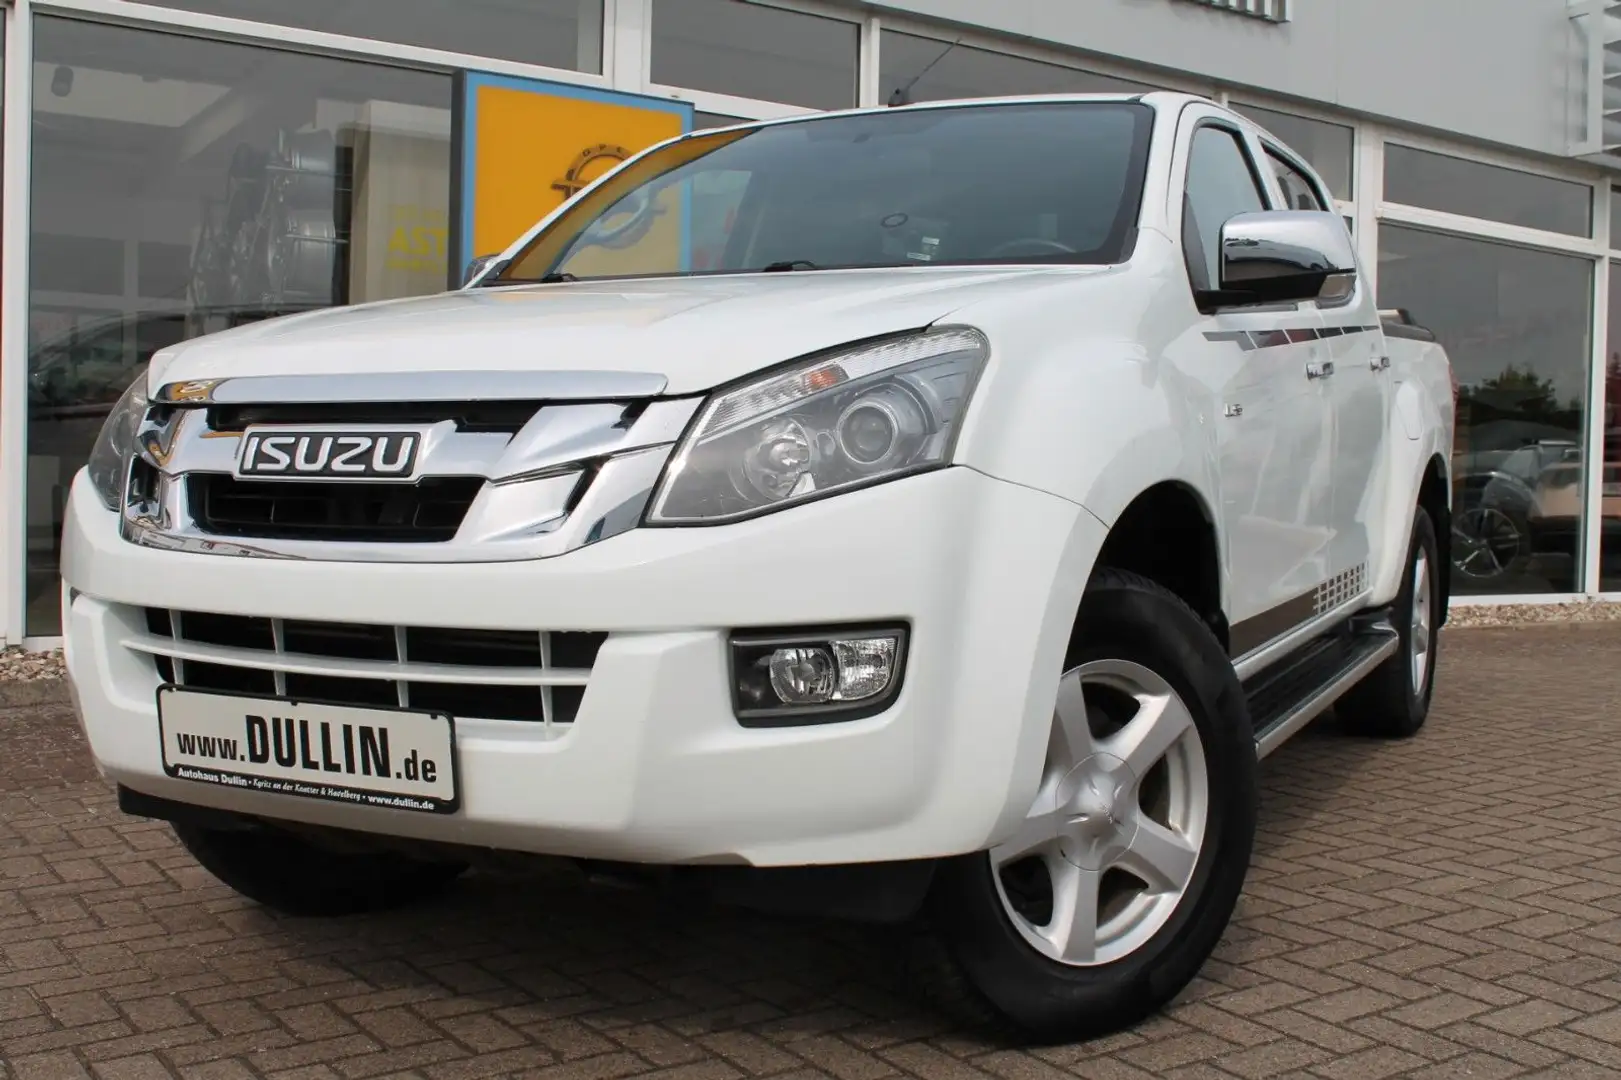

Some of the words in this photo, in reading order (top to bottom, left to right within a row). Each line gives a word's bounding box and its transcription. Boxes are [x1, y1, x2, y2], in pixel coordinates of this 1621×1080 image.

[243, 436, 413, 472] ISUZU
[176, 714, 437, 783] www.DULLIN.de
[178, 767, 219, 783] Autohaus
[221, 774, 248, 787] Dullin
[367, 794, 435, 810] www.dullin.de
